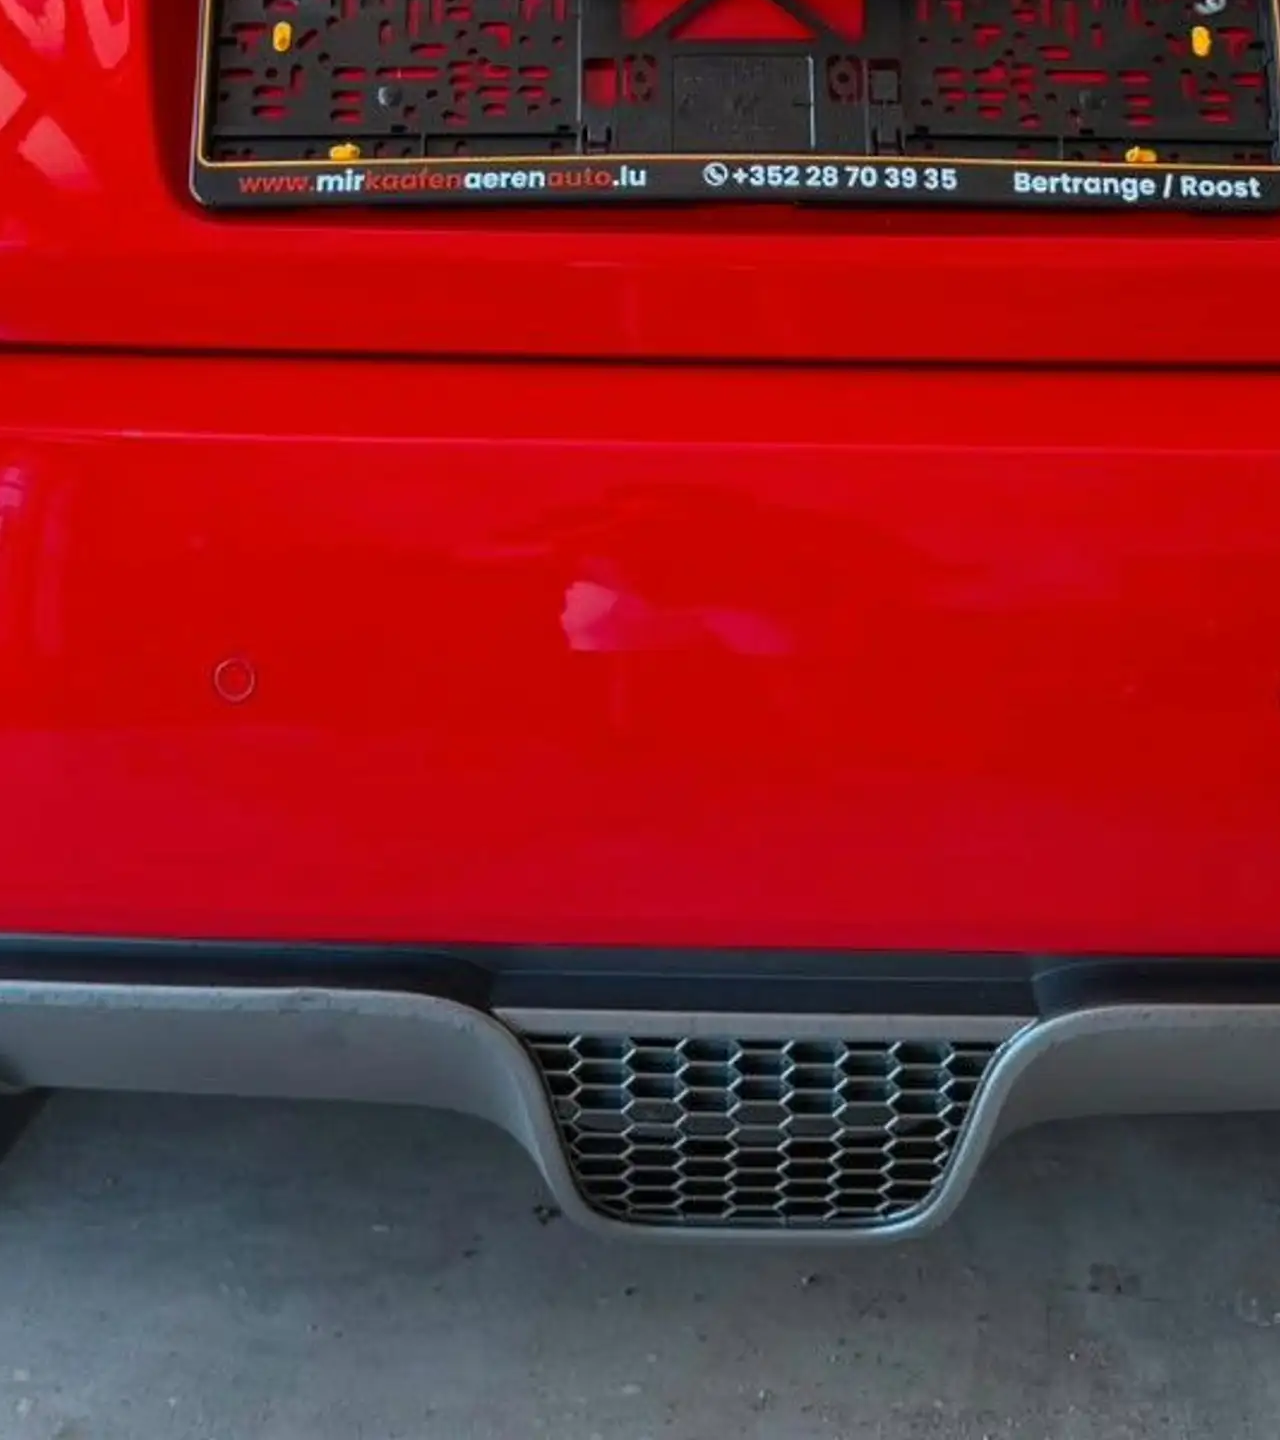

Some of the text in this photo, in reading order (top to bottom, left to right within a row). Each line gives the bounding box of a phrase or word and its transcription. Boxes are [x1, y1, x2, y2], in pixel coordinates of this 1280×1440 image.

[238, 166, 647, 193] www.mirkaafenaerenauto.lu
[732, 165, 958, 191] +352 28 70 39 35
[1013, 172, 1156, 202] Bertrange
[1180, 174, 1261, 199] Roost
